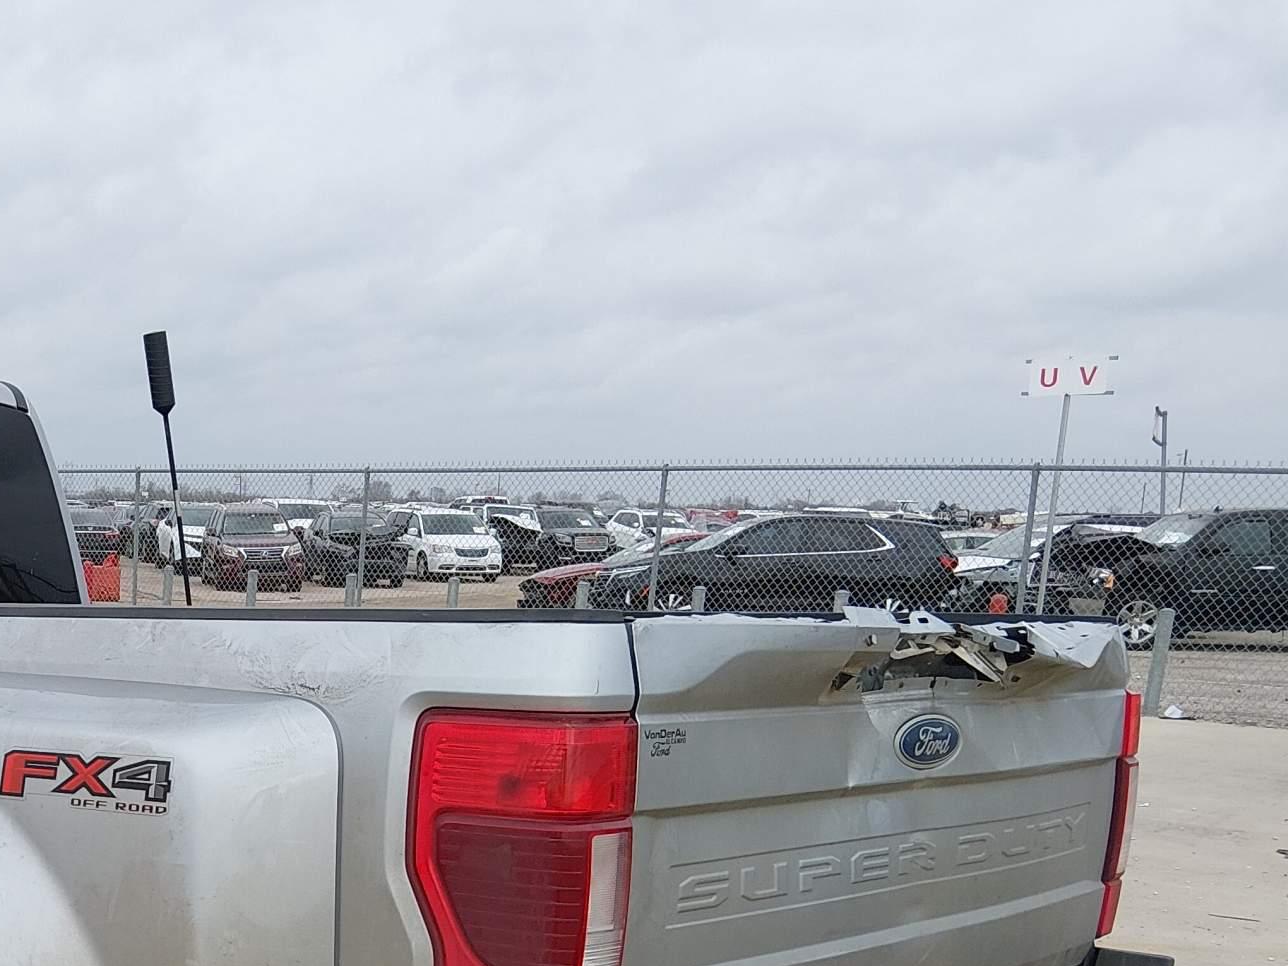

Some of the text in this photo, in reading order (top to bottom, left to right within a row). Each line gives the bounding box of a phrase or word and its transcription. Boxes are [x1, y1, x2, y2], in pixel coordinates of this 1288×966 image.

[1040, 365, 1098, 388] U V
[644, 728, 687, 740] VanDerAu
[914, 726, 952, 757] Ford
[650, 741, 672, 758] Ford
[0, 749, 172, 803] FX4
[70, 798, 167, 815] OFF ROAD
[677, 811, 1087, 914] SUPER DUTY
